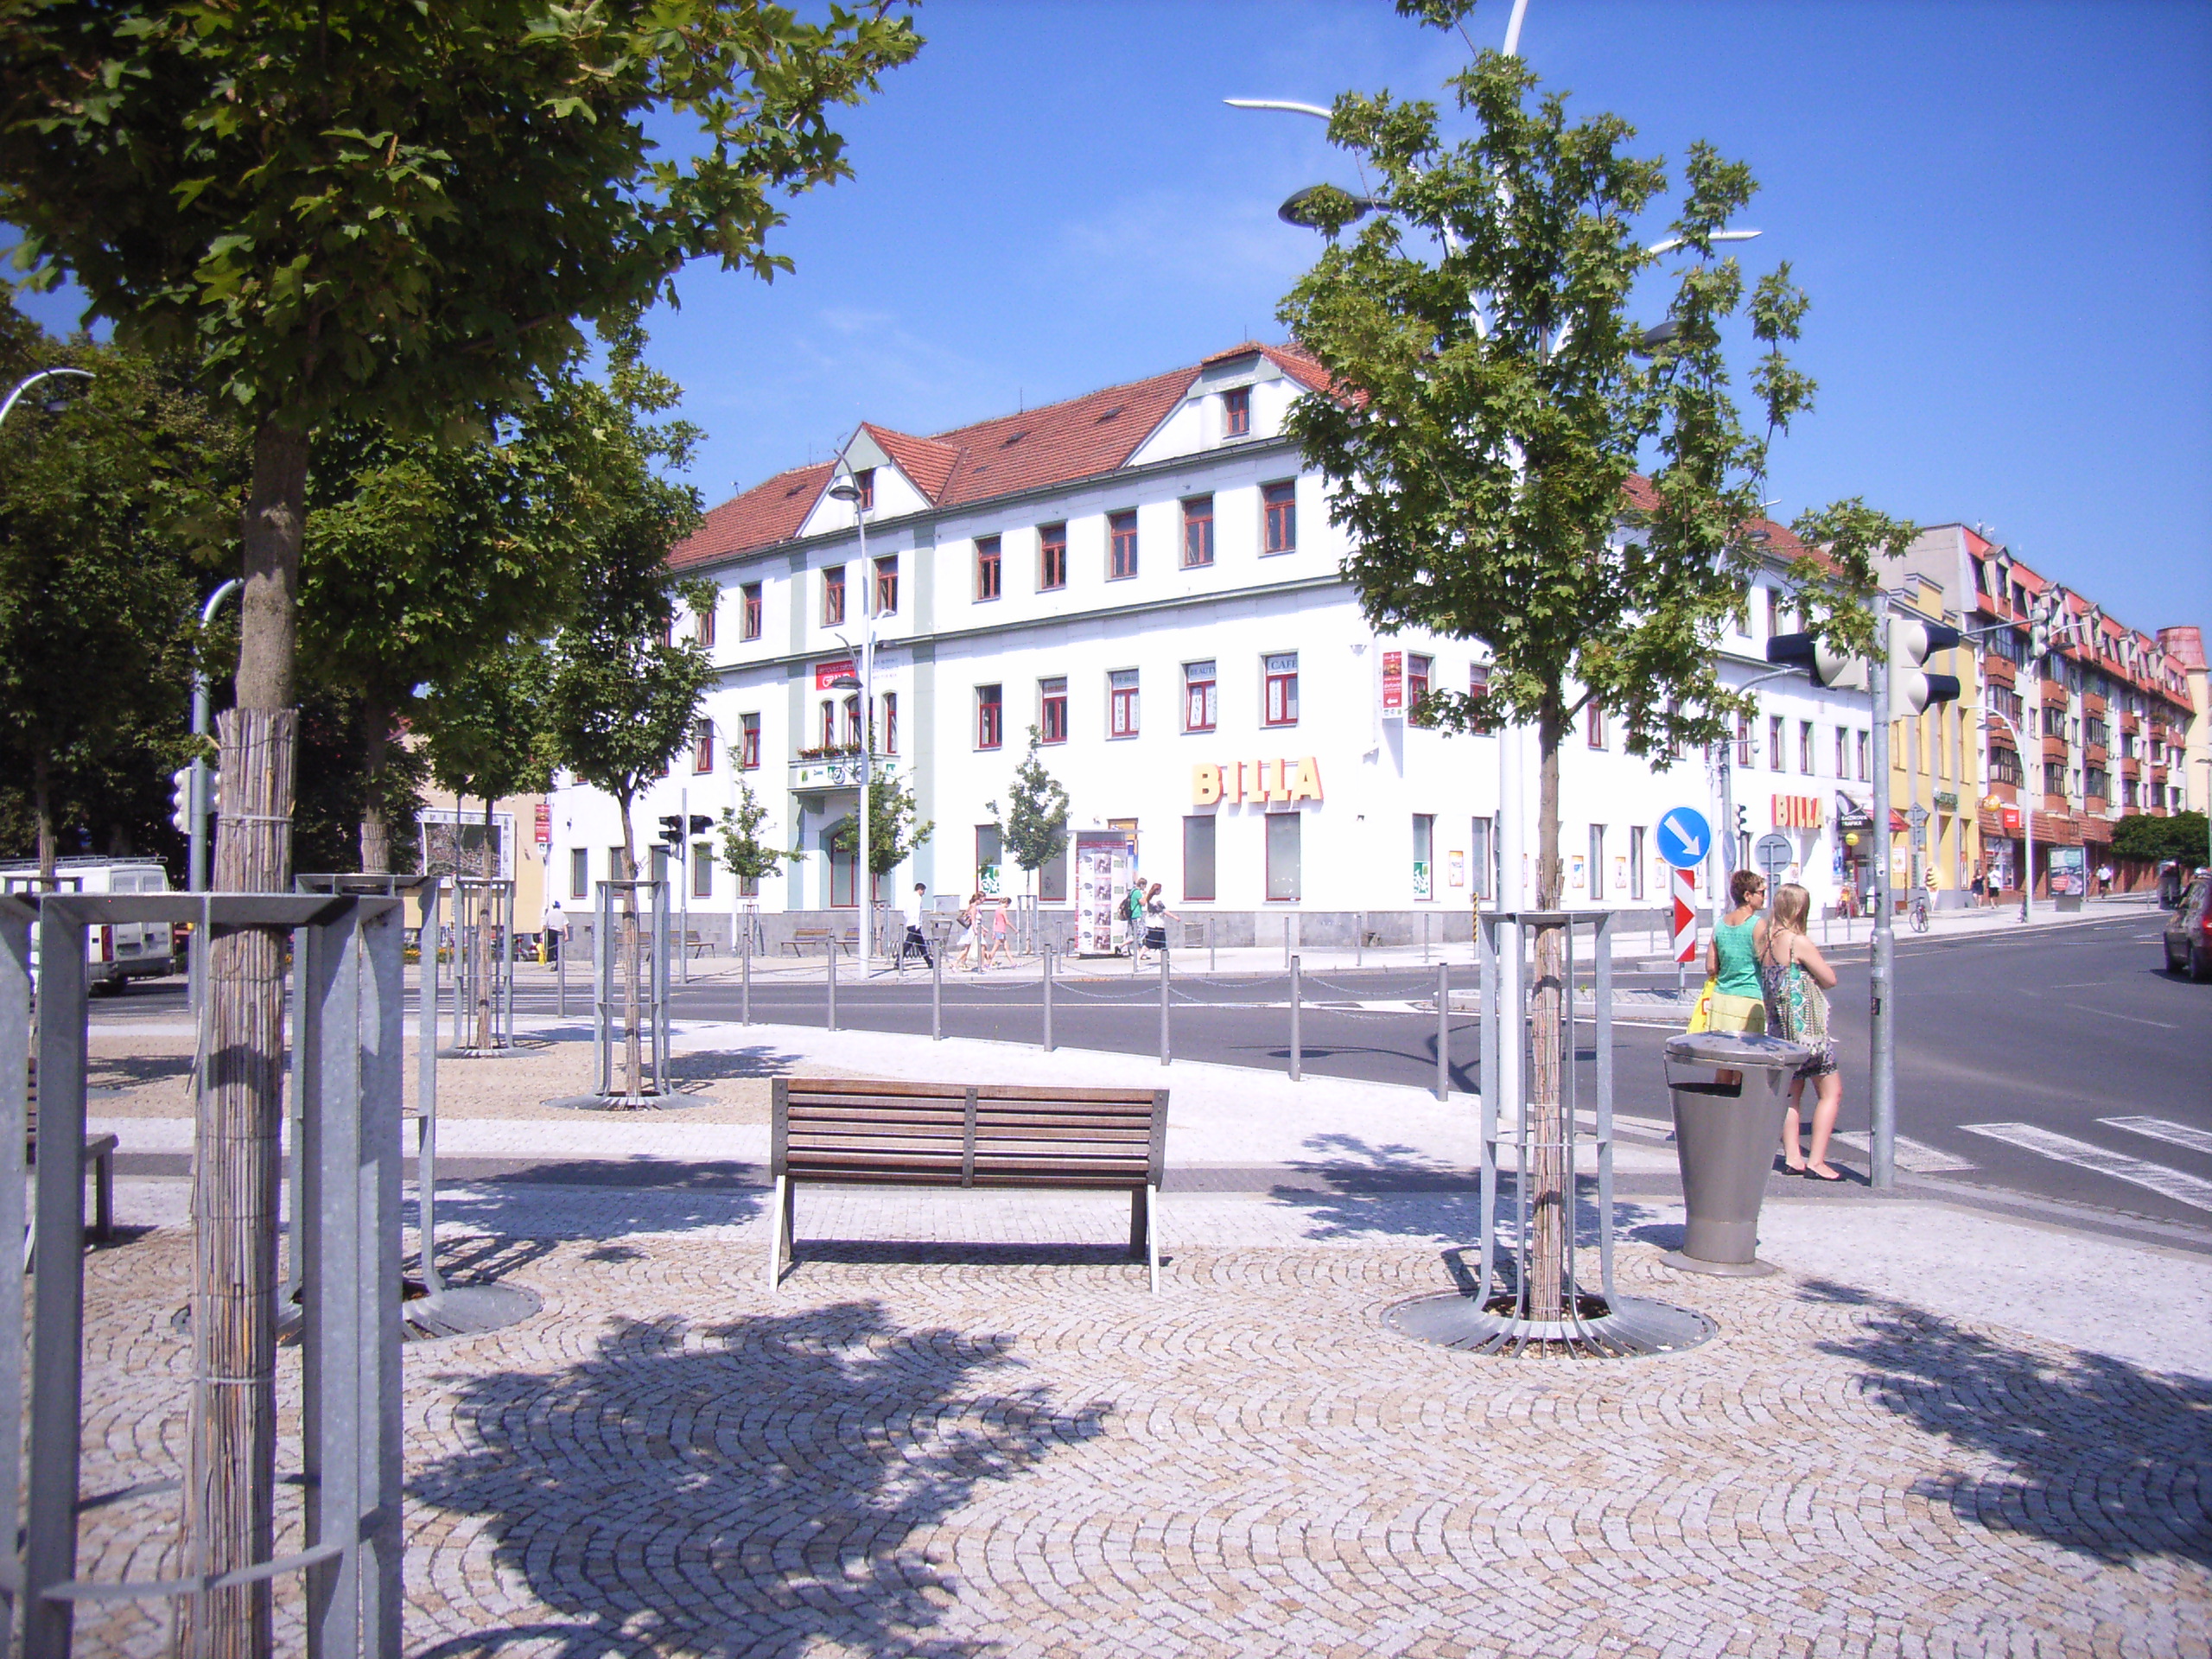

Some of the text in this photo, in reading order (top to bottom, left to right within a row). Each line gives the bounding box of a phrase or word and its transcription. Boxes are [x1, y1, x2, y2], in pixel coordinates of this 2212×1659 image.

[1271, 660, 1297, 671] CAFE
[1192, 756, 1323, 804] BILLA
[1771, 794, 1824, 828] BILLA
